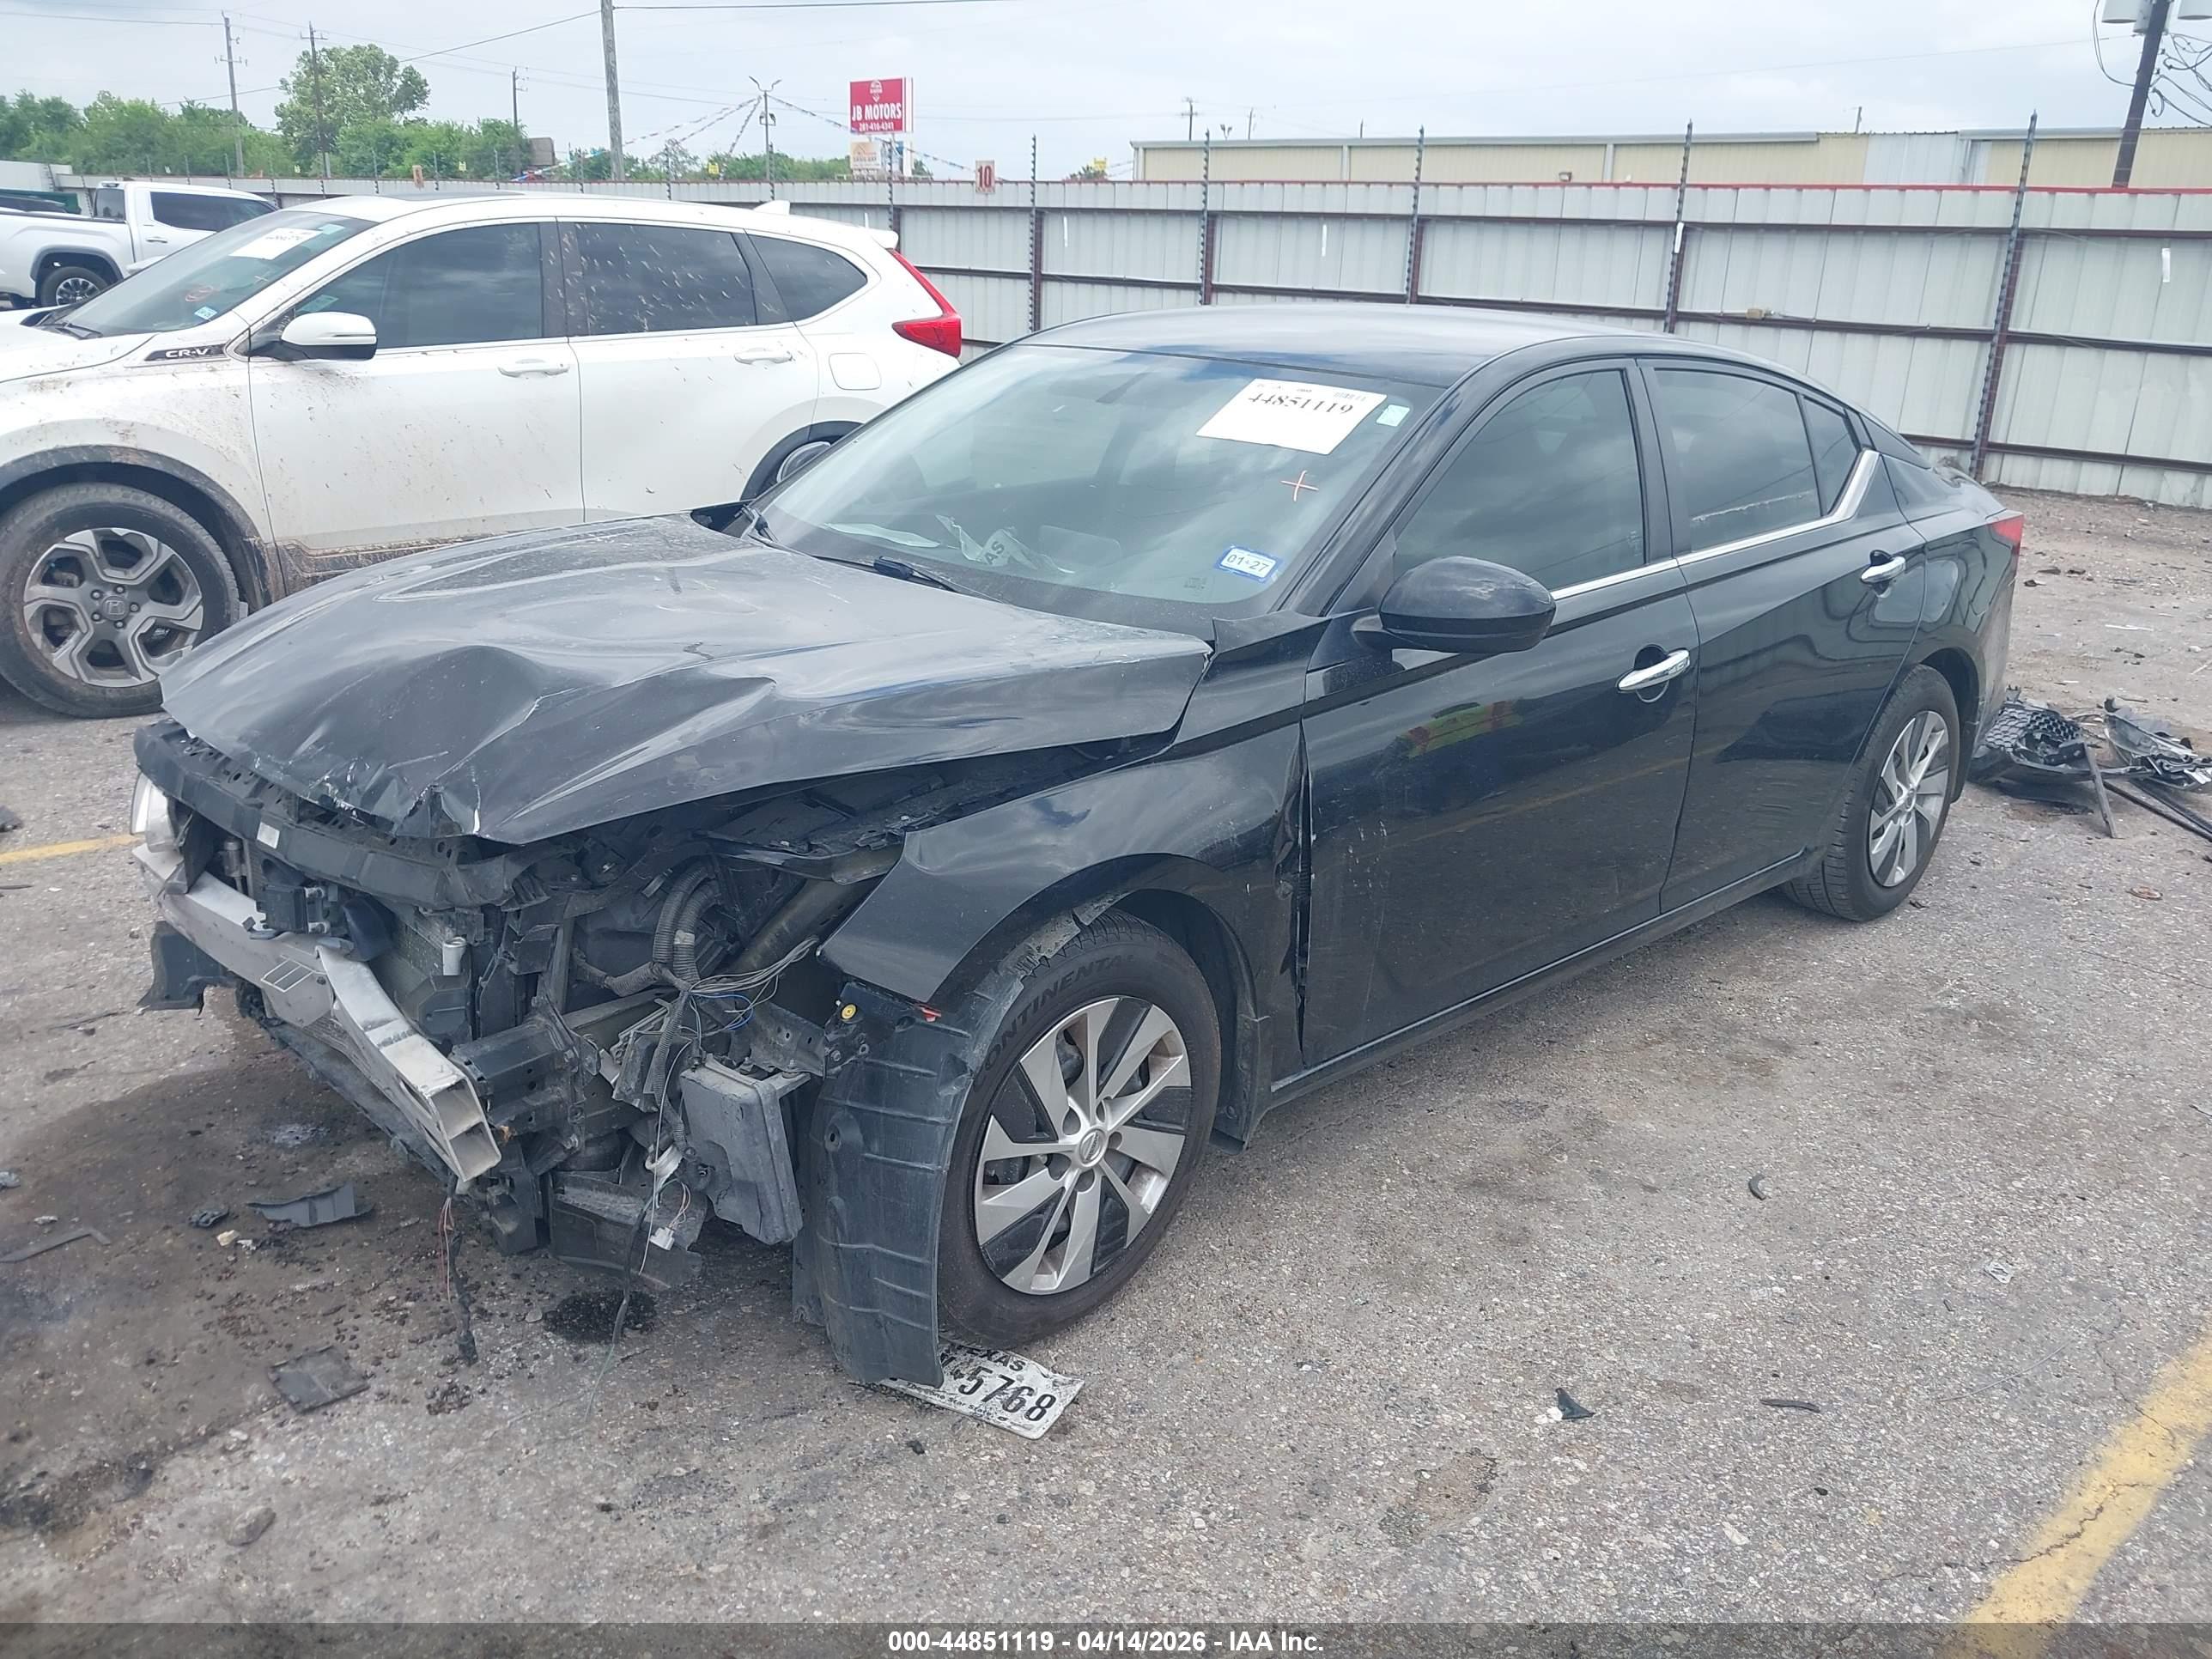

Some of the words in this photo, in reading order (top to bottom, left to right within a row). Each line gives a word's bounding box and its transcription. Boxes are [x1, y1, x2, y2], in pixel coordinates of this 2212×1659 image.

[851, 105, 863, 122] JB
[864, 102, 902, 121] MOTORS
[978, 166, 993, 188] 10
[165, 348, 209, 358] CR-V
[1248, 392, 1353, 414] 44851119
